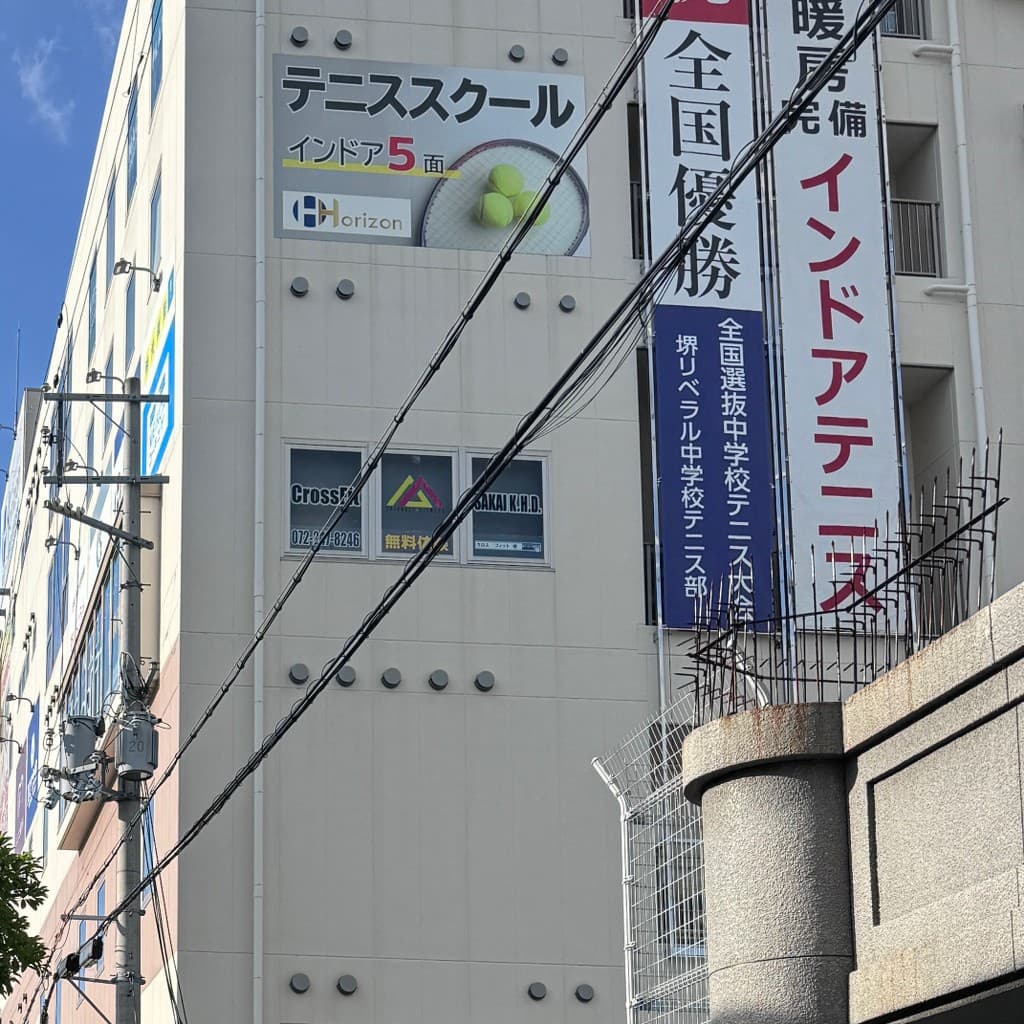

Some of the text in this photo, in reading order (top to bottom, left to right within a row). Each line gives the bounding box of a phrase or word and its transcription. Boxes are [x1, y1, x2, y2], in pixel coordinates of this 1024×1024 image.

[282, 66, 575, 129] テニススクール
[664, 29, 741, 300] 全国優勝
[318, 198, 403, 231] Horizon
[800, 153, 883, 612] インドアテニス
[675, 334, 708, 599] 堺リベラル中学校テニス部
[385, 534, 449, 551] 無料体
[128, 741, 145, 752] 20
